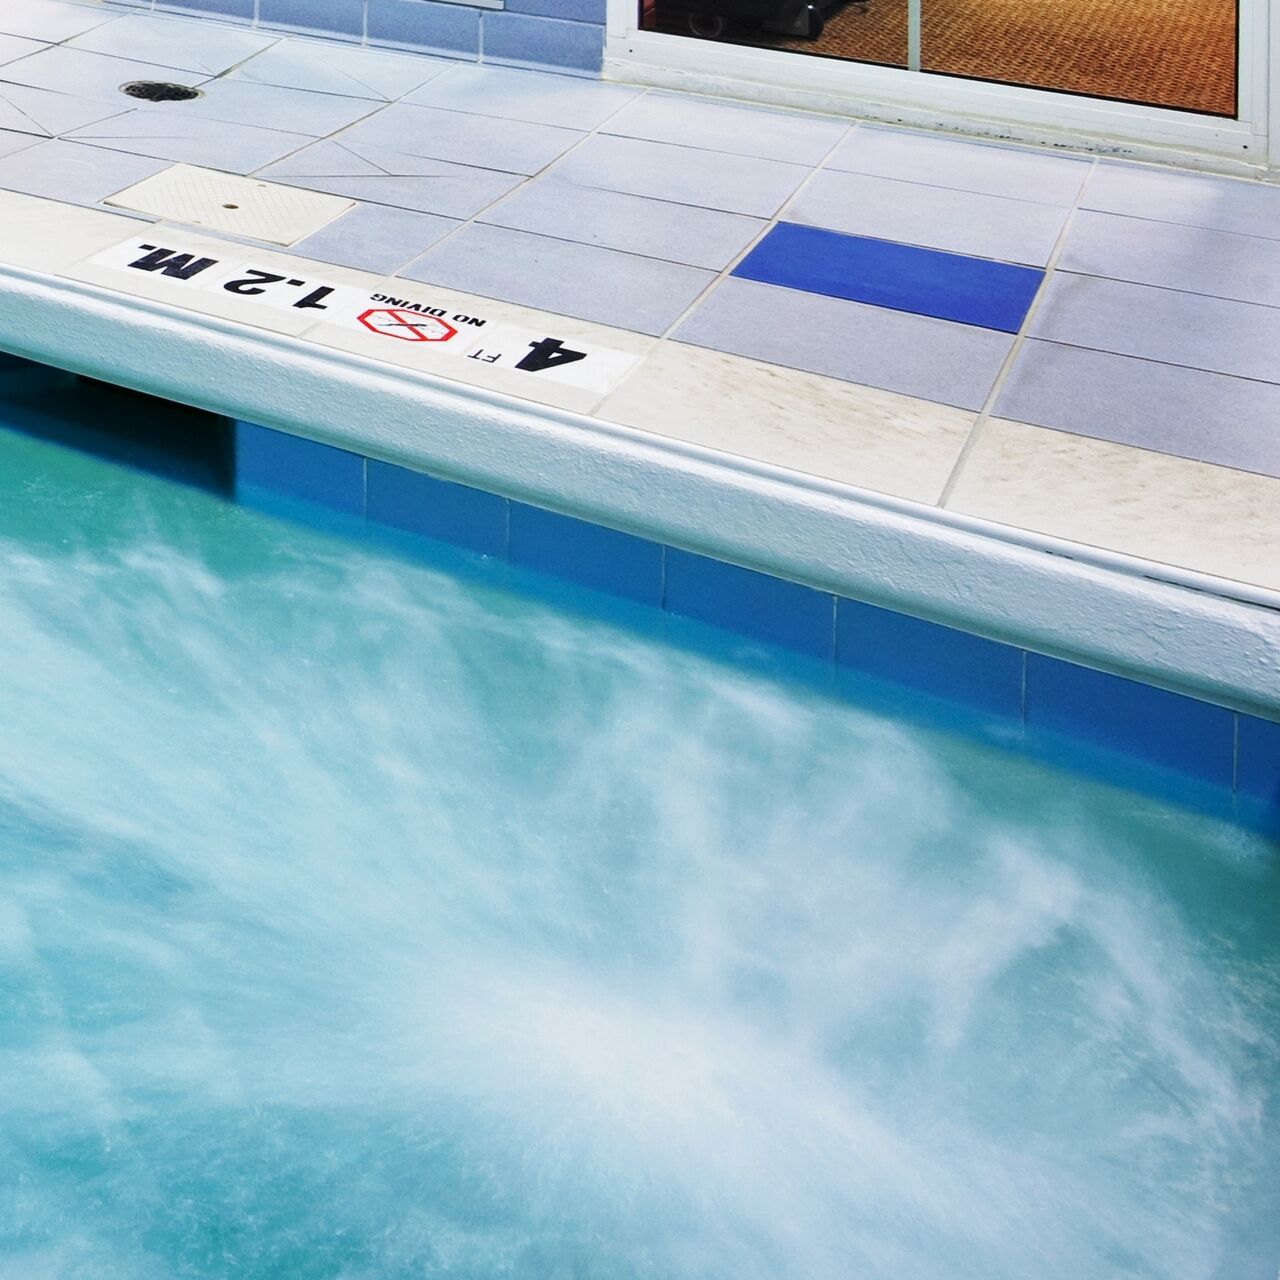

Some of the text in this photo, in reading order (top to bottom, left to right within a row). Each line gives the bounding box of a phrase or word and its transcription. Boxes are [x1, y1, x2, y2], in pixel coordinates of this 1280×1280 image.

[223, 269, 336, 311] 1.2
[370, 292, 487, 328] NO DIVING
[468, 337, 588, 373] 4 FT
